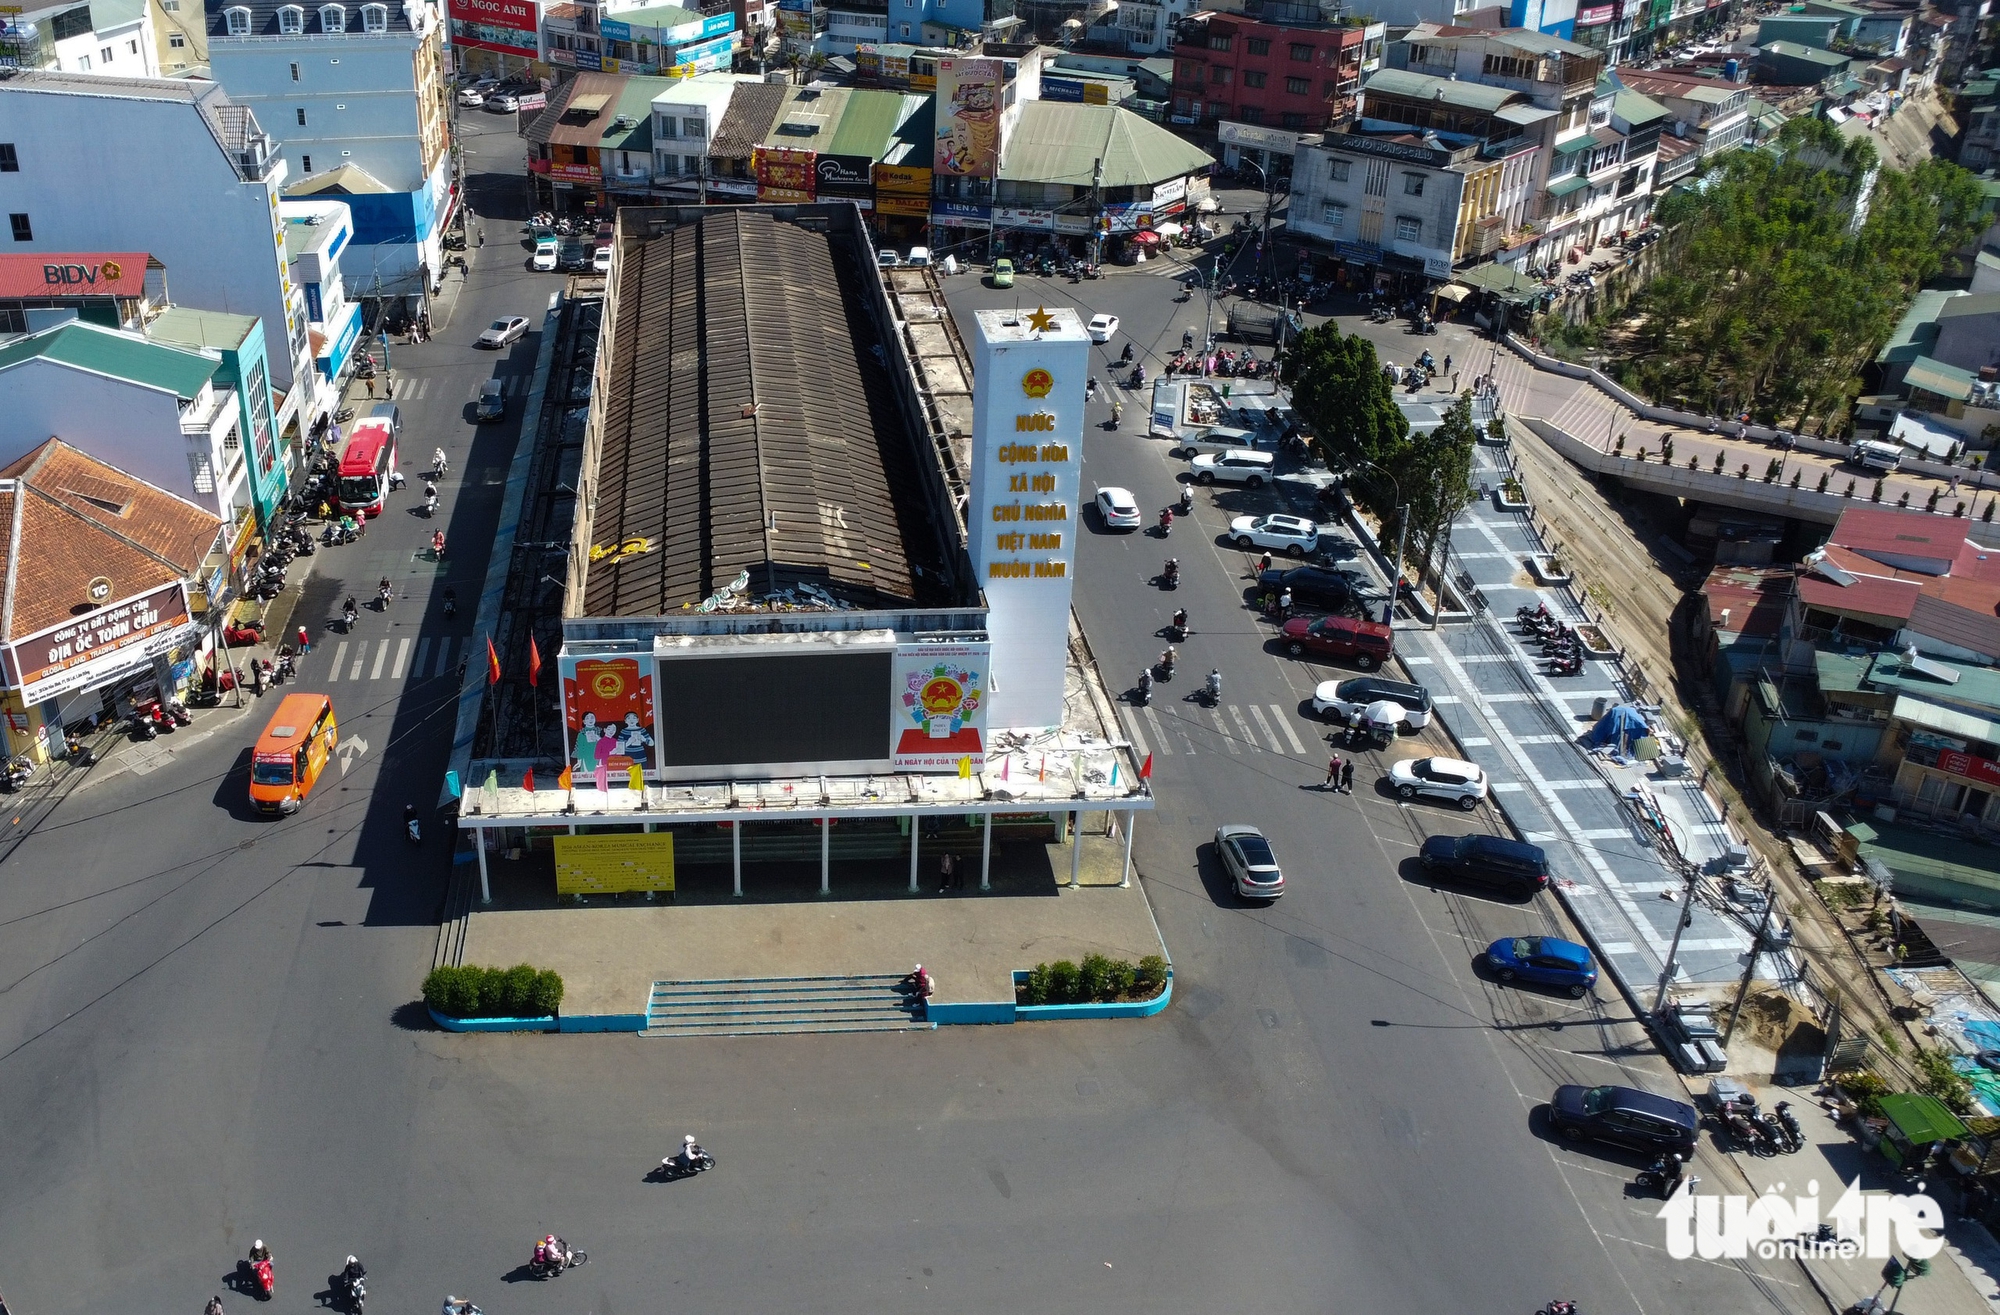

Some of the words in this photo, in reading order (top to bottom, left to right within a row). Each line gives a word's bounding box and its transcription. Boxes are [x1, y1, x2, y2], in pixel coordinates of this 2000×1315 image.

[471, 0, 500, 13] NGỌC
[503, 2, 527, 17] ANH
[1048, 85, 1080, 96] MICHELIN
[889, 172, 913, 180] Kodak
[895, 199, 924, 208] DALAT
[43, 263, 100, 284] BIDV
[1016, 411, 1055, 432] NƯỚC
[999, 441, 1037, 466] CỘNG
[1041, 442, 1068, 462] HÒA
[1009, 472, 1028, 492] XÃ
[1032, 471, 1055, 495] HỘI
[993, 499, 1021, 521] CHỦ
[1024, 500, 1067, 521] NGHĨA
[997, 530, 1025, 553] VIỆT
[1029, 533, 1061, 549] NAM
[989, 558, 1030, 578] MUÔN
[1034, 558, 1066, 578] NĂM
[92, 585, 109, 598] TC
[54, 628, 76, 644] CÔNG
[78, 623, 89, 636] TY
[91, 615, 107, 631] BẤT
[107, 607, 131, 624] ĐỘNG
[48, 645, 71, 664] ĐỊA
[76, 634, 93, 654] ỐC
[99, 622, 130, 643] TOÀN
[133, 609, 158, 631] CẦU
[41, 663, 66, 678] GLOBAL
[70, 655, 86, 668] LAND
[90, 645, 116, 659] TRADING
[119, 631, 147, 647] COMPANY
[895, 758, 903, 766] LÀ
[904, 757, 922, 766] NGÀY
[923, 757, 934, 767] HỘI
[936, 756, 949, 765] CỦA
